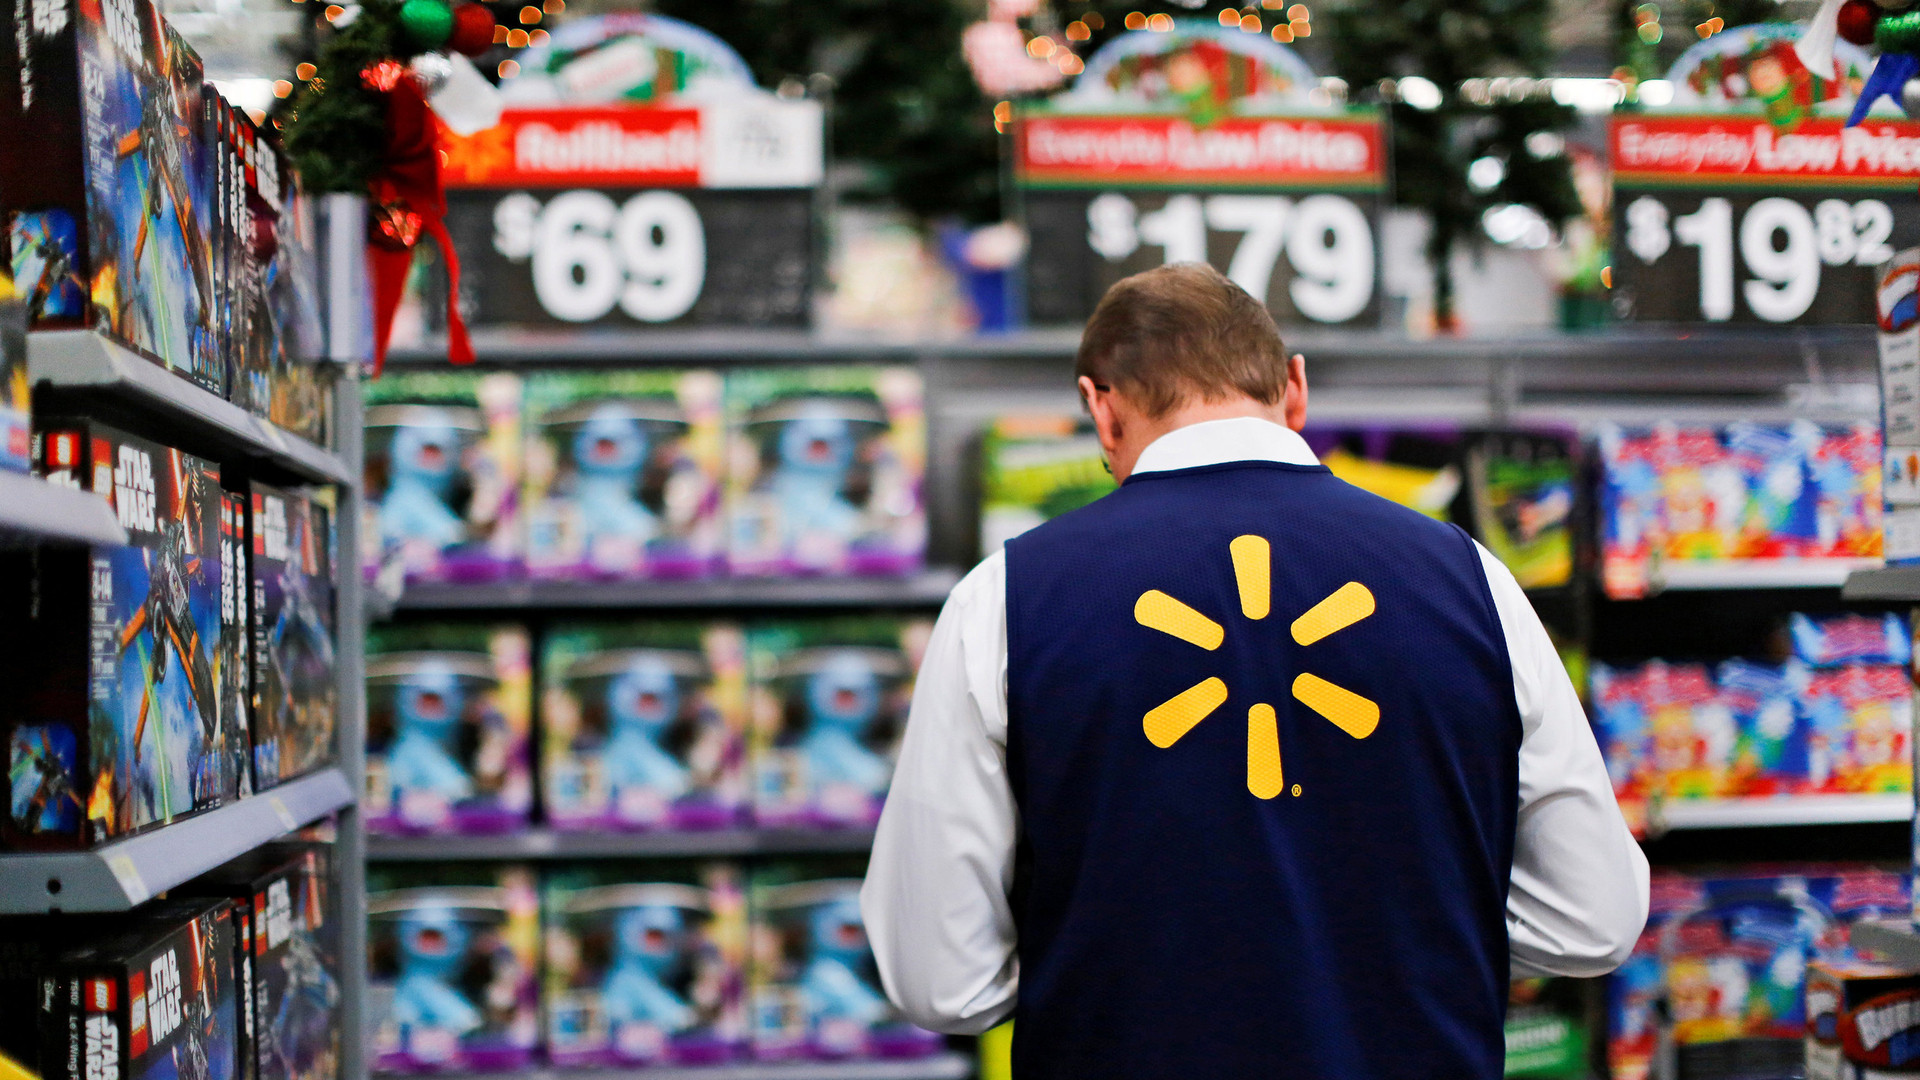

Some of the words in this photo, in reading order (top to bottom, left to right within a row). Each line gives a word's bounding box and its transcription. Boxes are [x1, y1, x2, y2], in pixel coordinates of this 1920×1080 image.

[492, 188, 707, 324] $69
[114, 444, 154, 495] STAR
[115, 483, 156, 532] WARS
[70, 977, 80, 1006] 75102
[95, 980, 107, 1010] LEGO
[148, 948, 181, 1008] STAR
[69, 1015, 79, 1030] Le
[149, 983, 182, 1047] WARS
[67, 1033, 80, 1072] X-Wing
